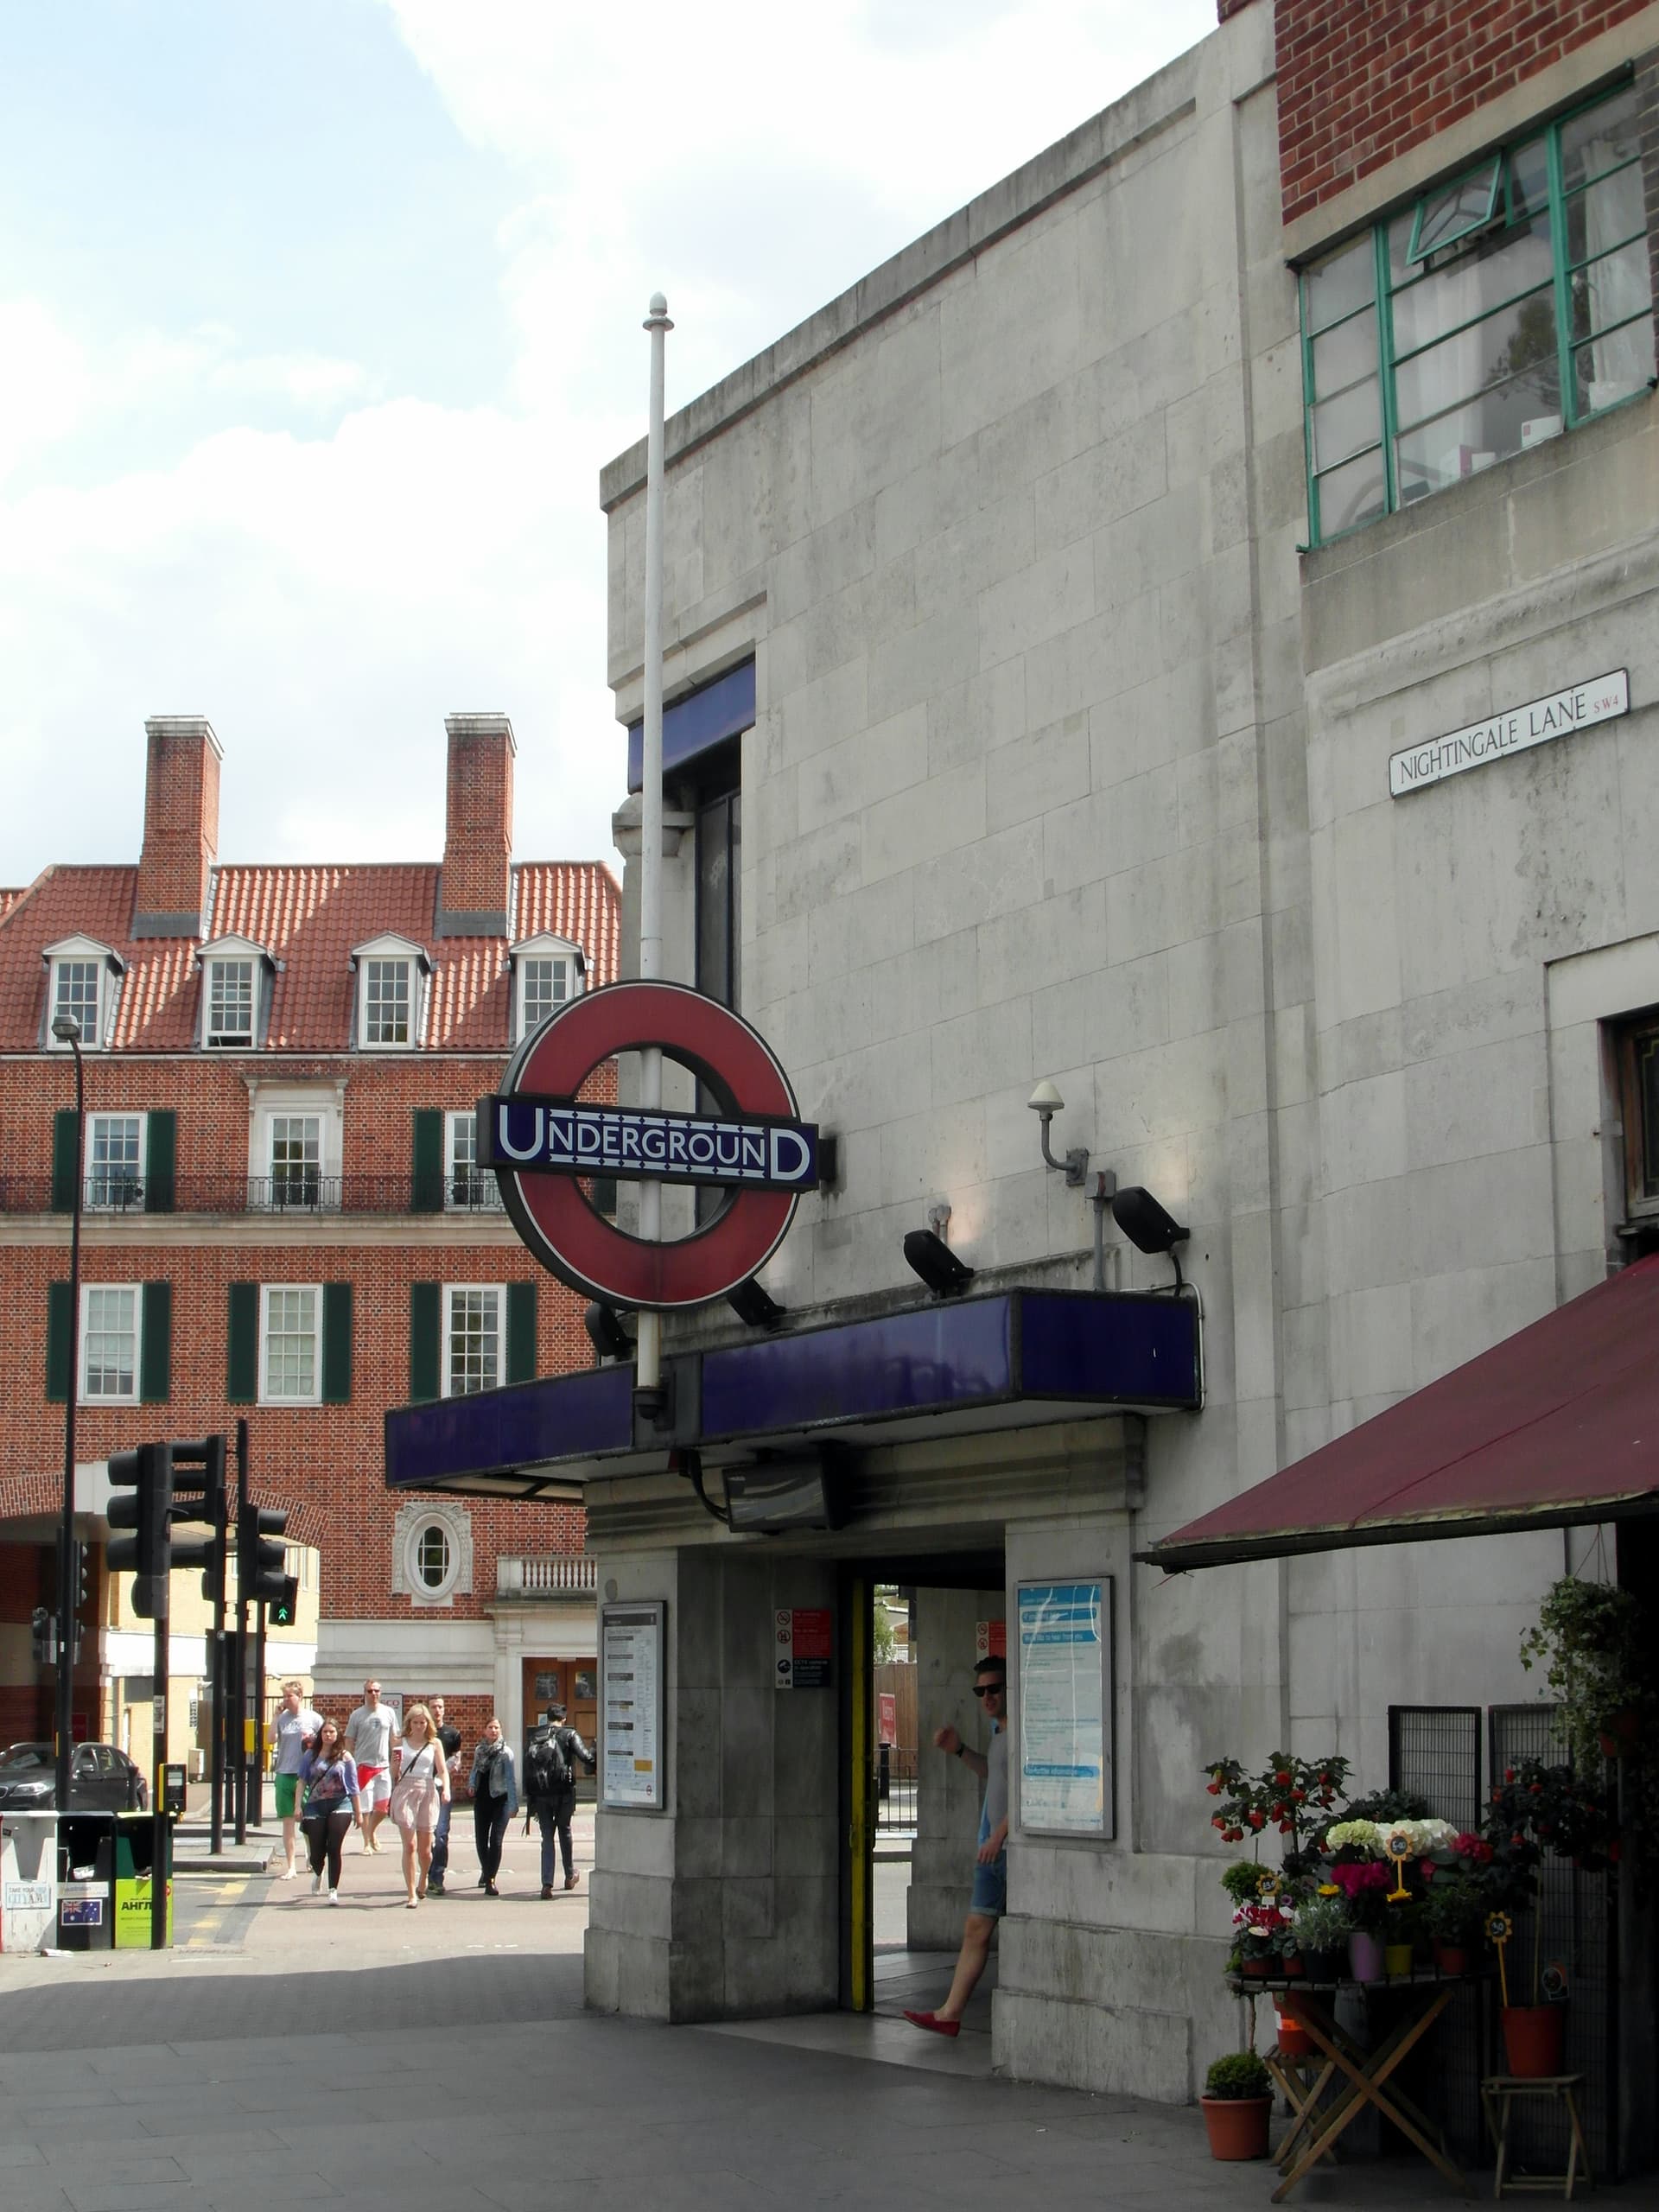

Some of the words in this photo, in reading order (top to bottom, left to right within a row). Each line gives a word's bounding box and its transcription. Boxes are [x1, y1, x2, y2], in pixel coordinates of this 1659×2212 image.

[1400, 718, 1519, 784] NIGHTINGALE
[1529, 693, 1586, 737] LANE
[1593, 694, 1619, 714] SW4
[499, 1104, 810, 1181] UNDERGROUND
[121, 1901, 152, 1910] АНГЛ
